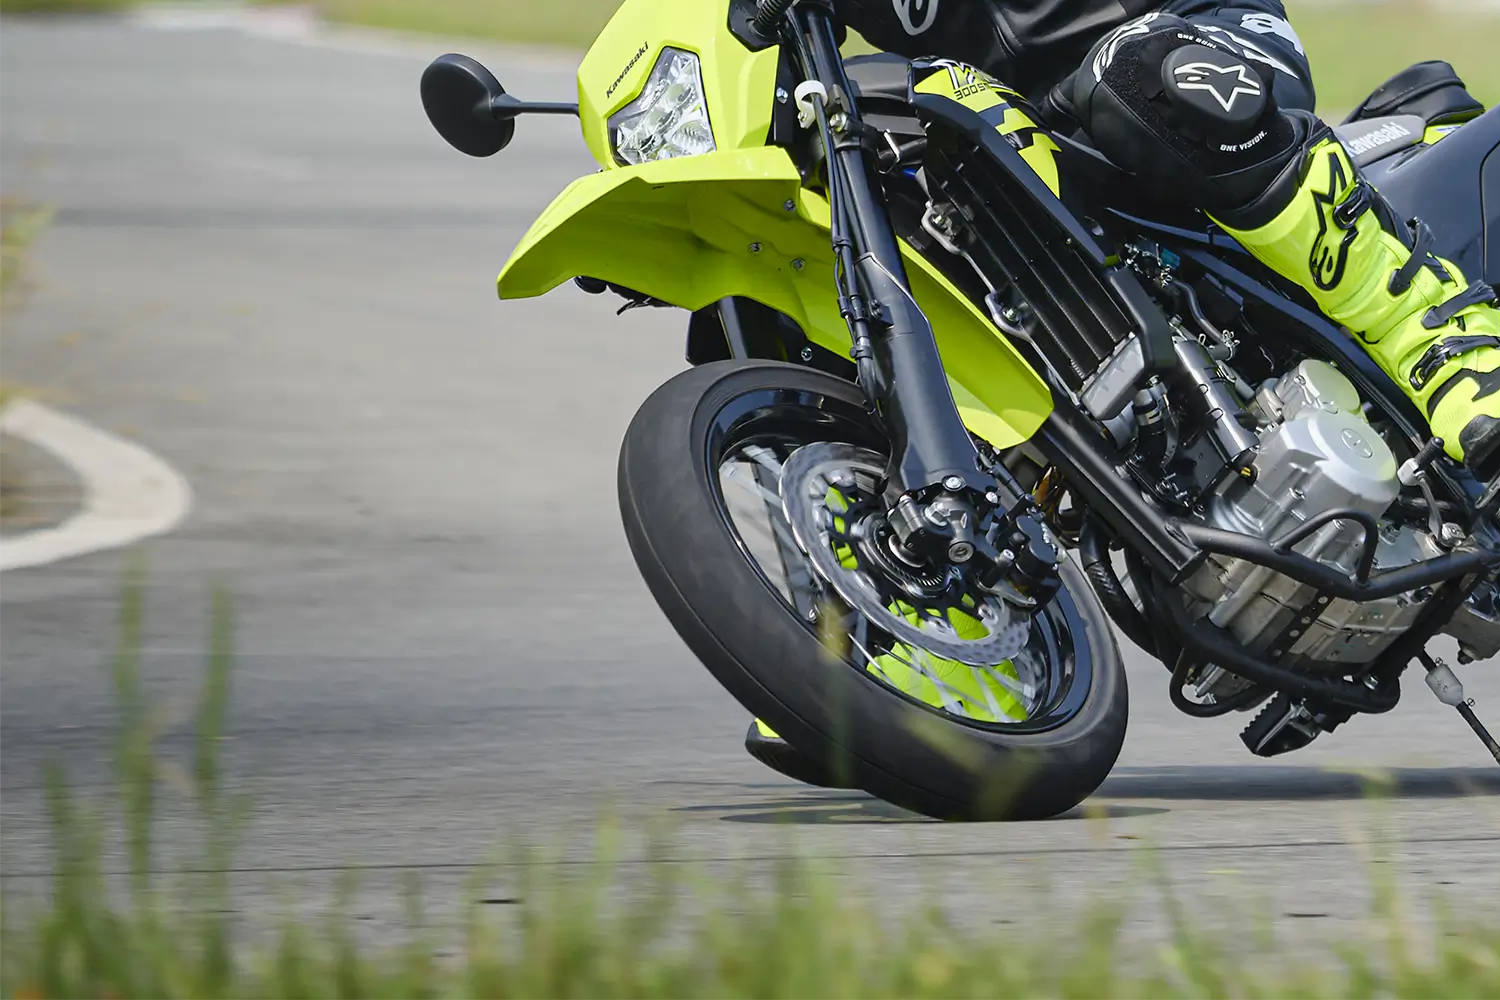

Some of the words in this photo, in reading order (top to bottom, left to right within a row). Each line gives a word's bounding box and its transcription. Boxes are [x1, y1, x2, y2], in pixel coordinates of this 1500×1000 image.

[606, 41, 649, 99] Kawasaki
[1219, 144, 1238, 152] ONE
[1239, 130, 1268, 150] VISION.
